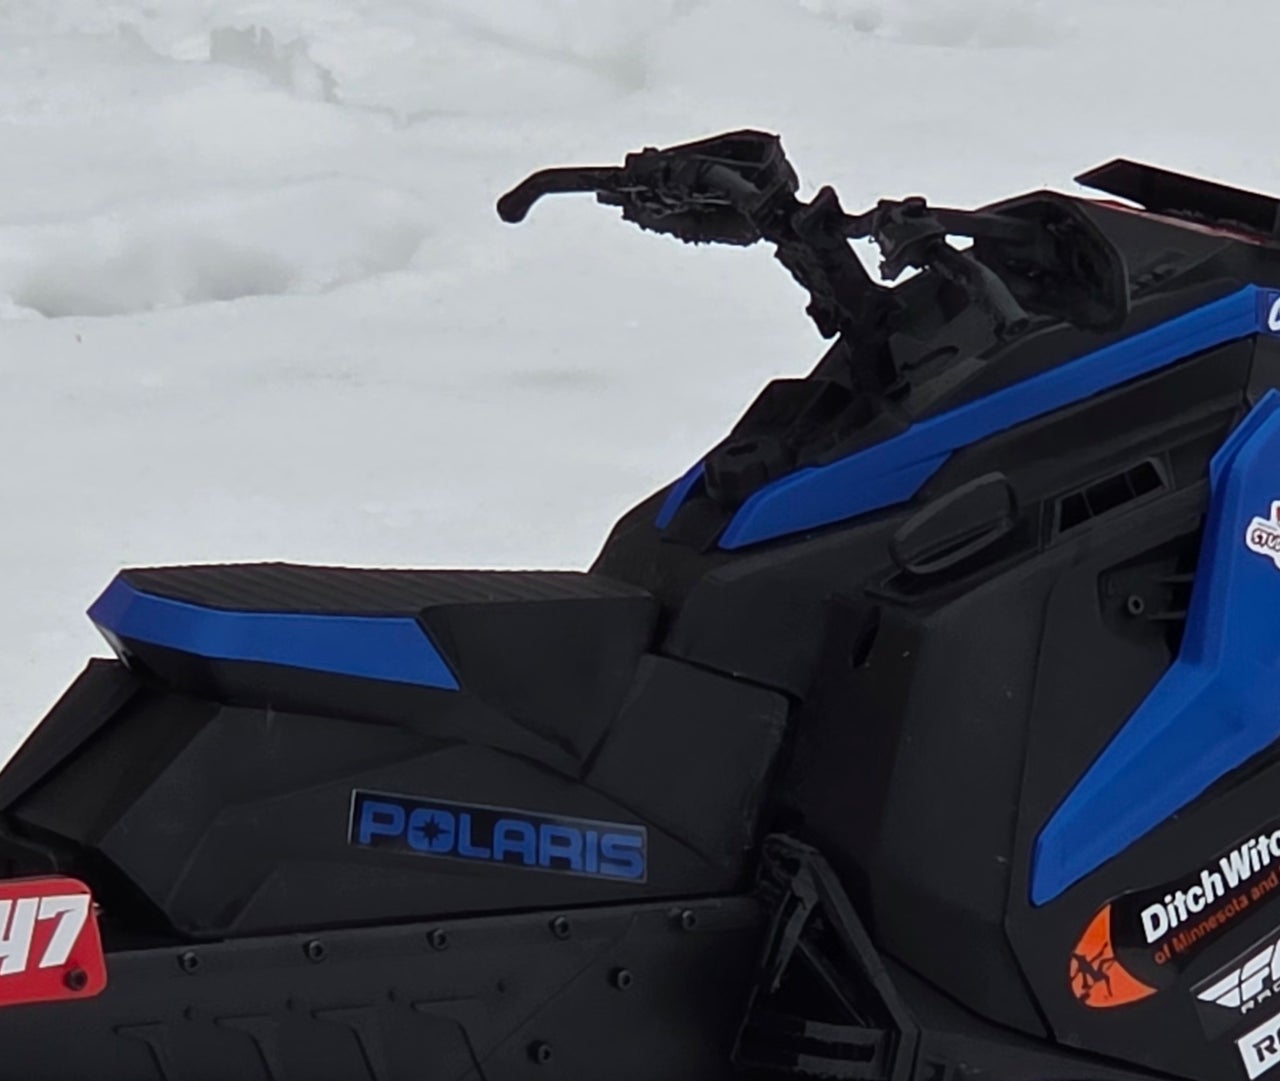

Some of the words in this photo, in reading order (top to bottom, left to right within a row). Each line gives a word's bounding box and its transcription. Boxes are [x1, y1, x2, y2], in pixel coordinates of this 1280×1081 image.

[358, 800, 646, 879] POLARIS
[1154, 943, 1171, 965] of
[1172, 894, 1249, 952] Minnesota
[1250, 871, 1279, 900] and
